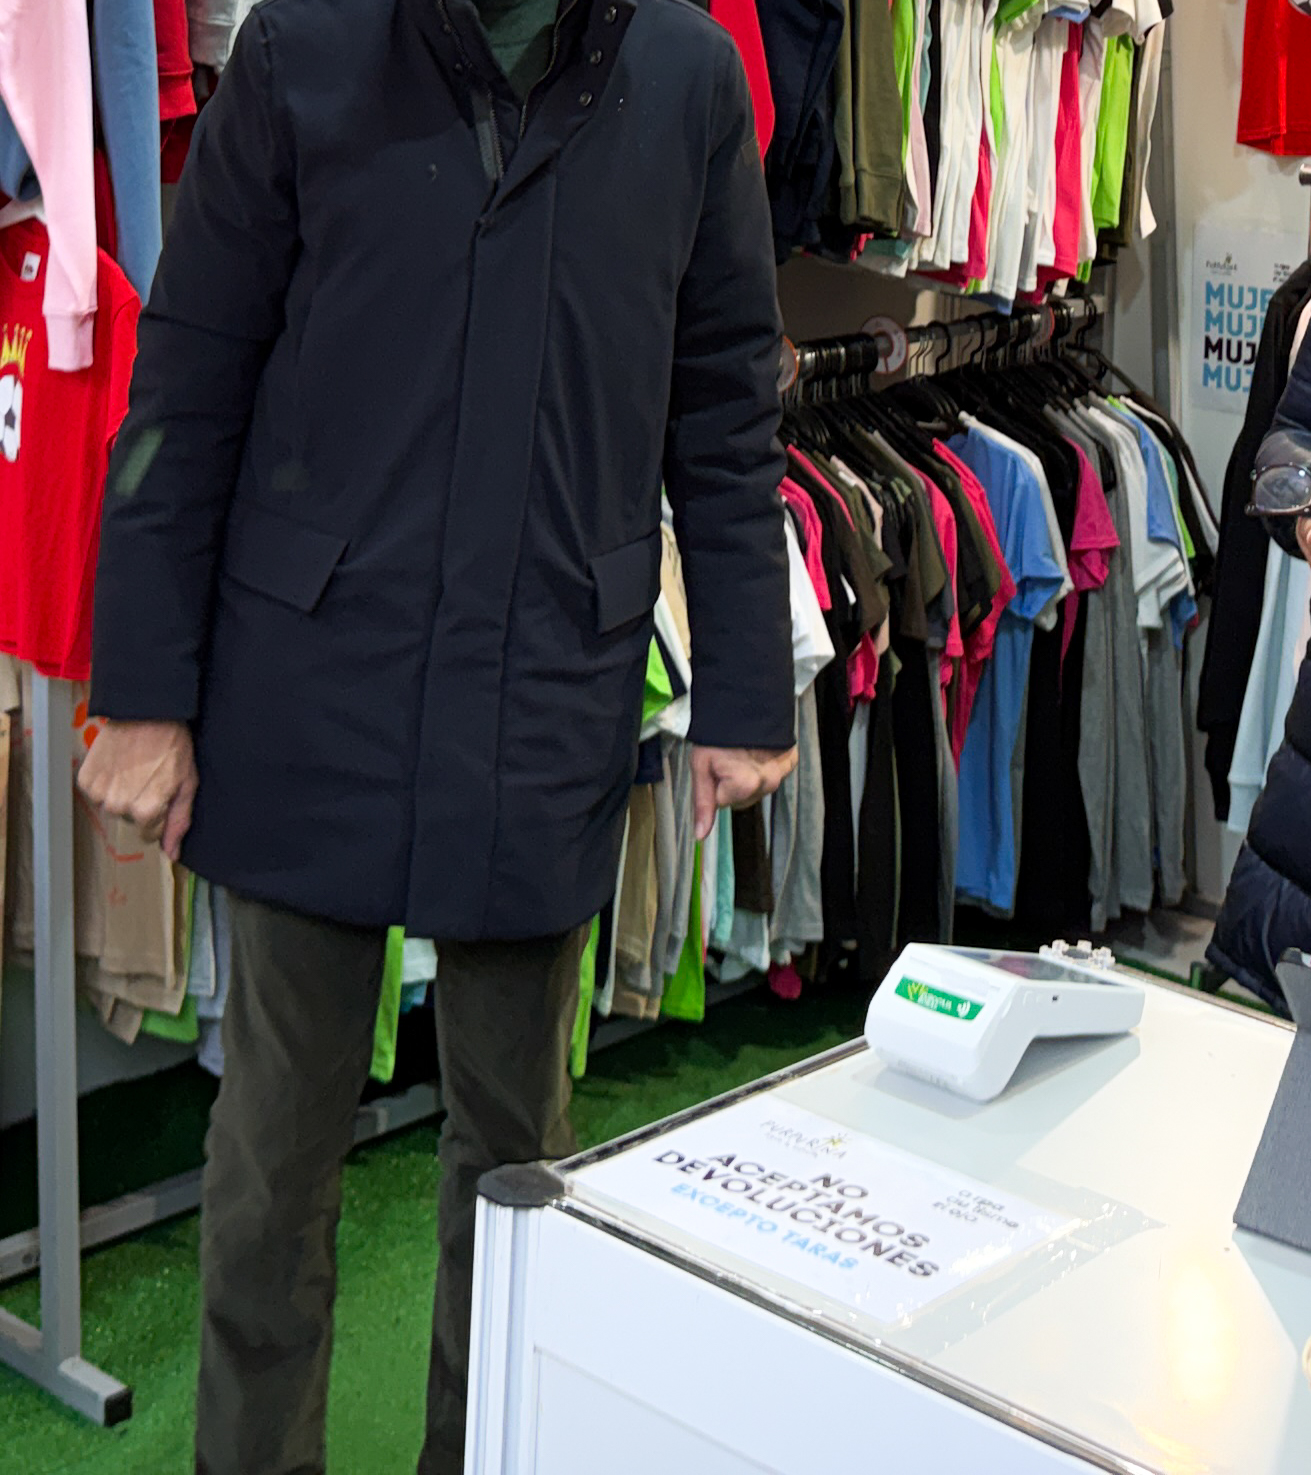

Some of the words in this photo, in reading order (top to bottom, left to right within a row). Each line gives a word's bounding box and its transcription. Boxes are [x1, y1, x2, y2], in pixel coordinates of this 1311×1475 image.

[1204, 335, 1258, 366] MUJ
[653, 1148, 940, 1278] DEVOLUCIONES
[670, 1182, 779, 1234] EXCEPTO
[781, 1229, 859, 1271] TARAS
[706, 1152, 930, 1250] ACEPTAMOS
[807, 1172, 869, 1200] NO
